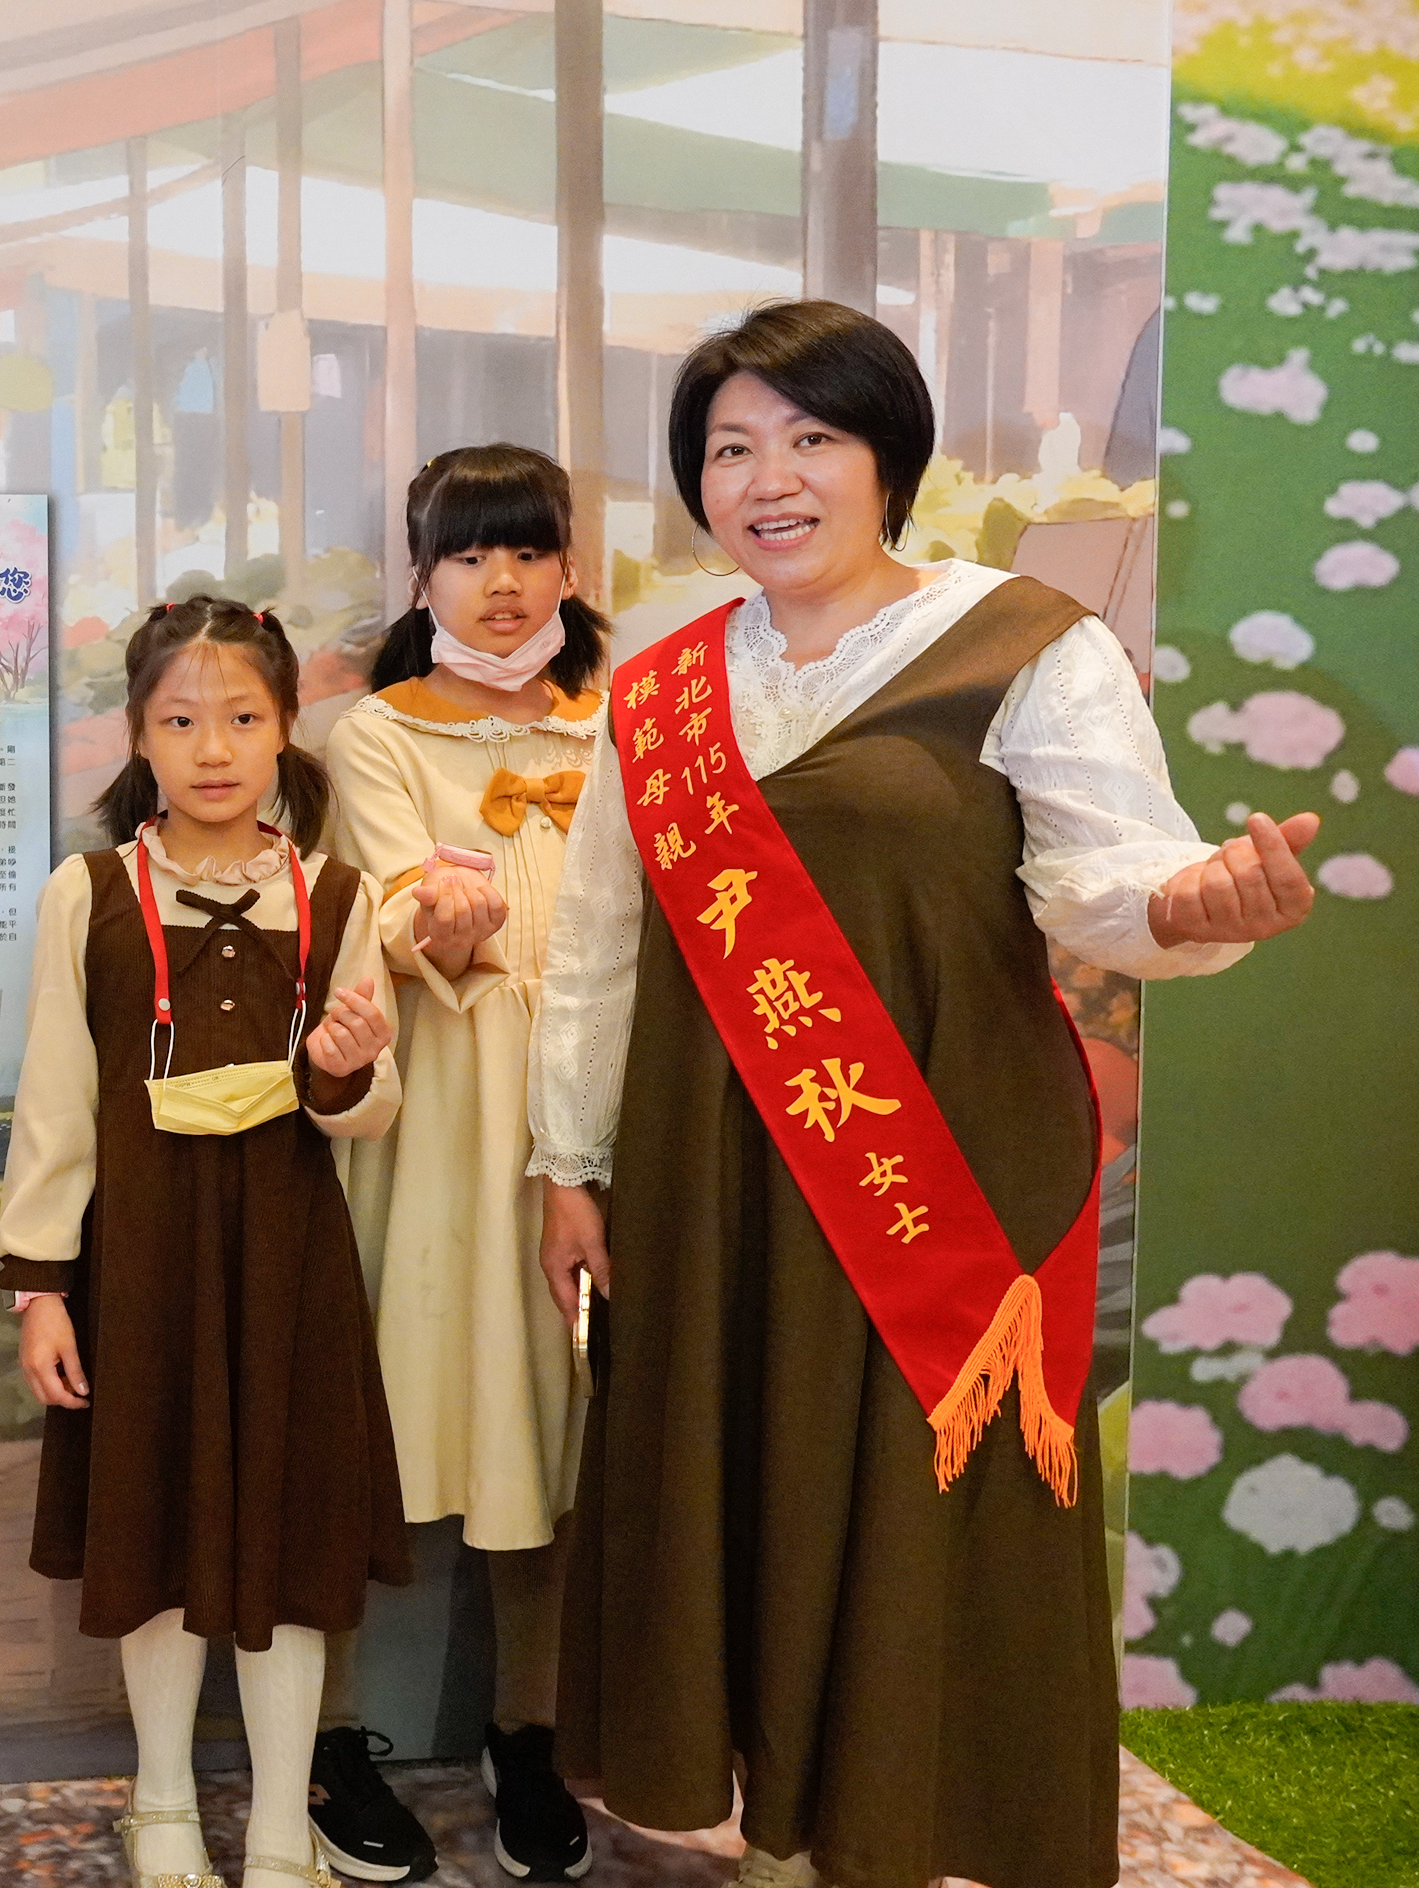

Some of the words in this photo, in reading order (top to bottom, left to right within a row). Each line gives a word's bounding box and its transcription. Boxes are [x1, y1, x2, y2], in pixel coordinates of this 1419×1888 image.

[623, 669, 697, 871] 模範母親
[671, 641, 740, 837] 新北市115年
[696, 868, 903, 1143] 尹燕秋
[859, 1151, 931, 1245] 女士
